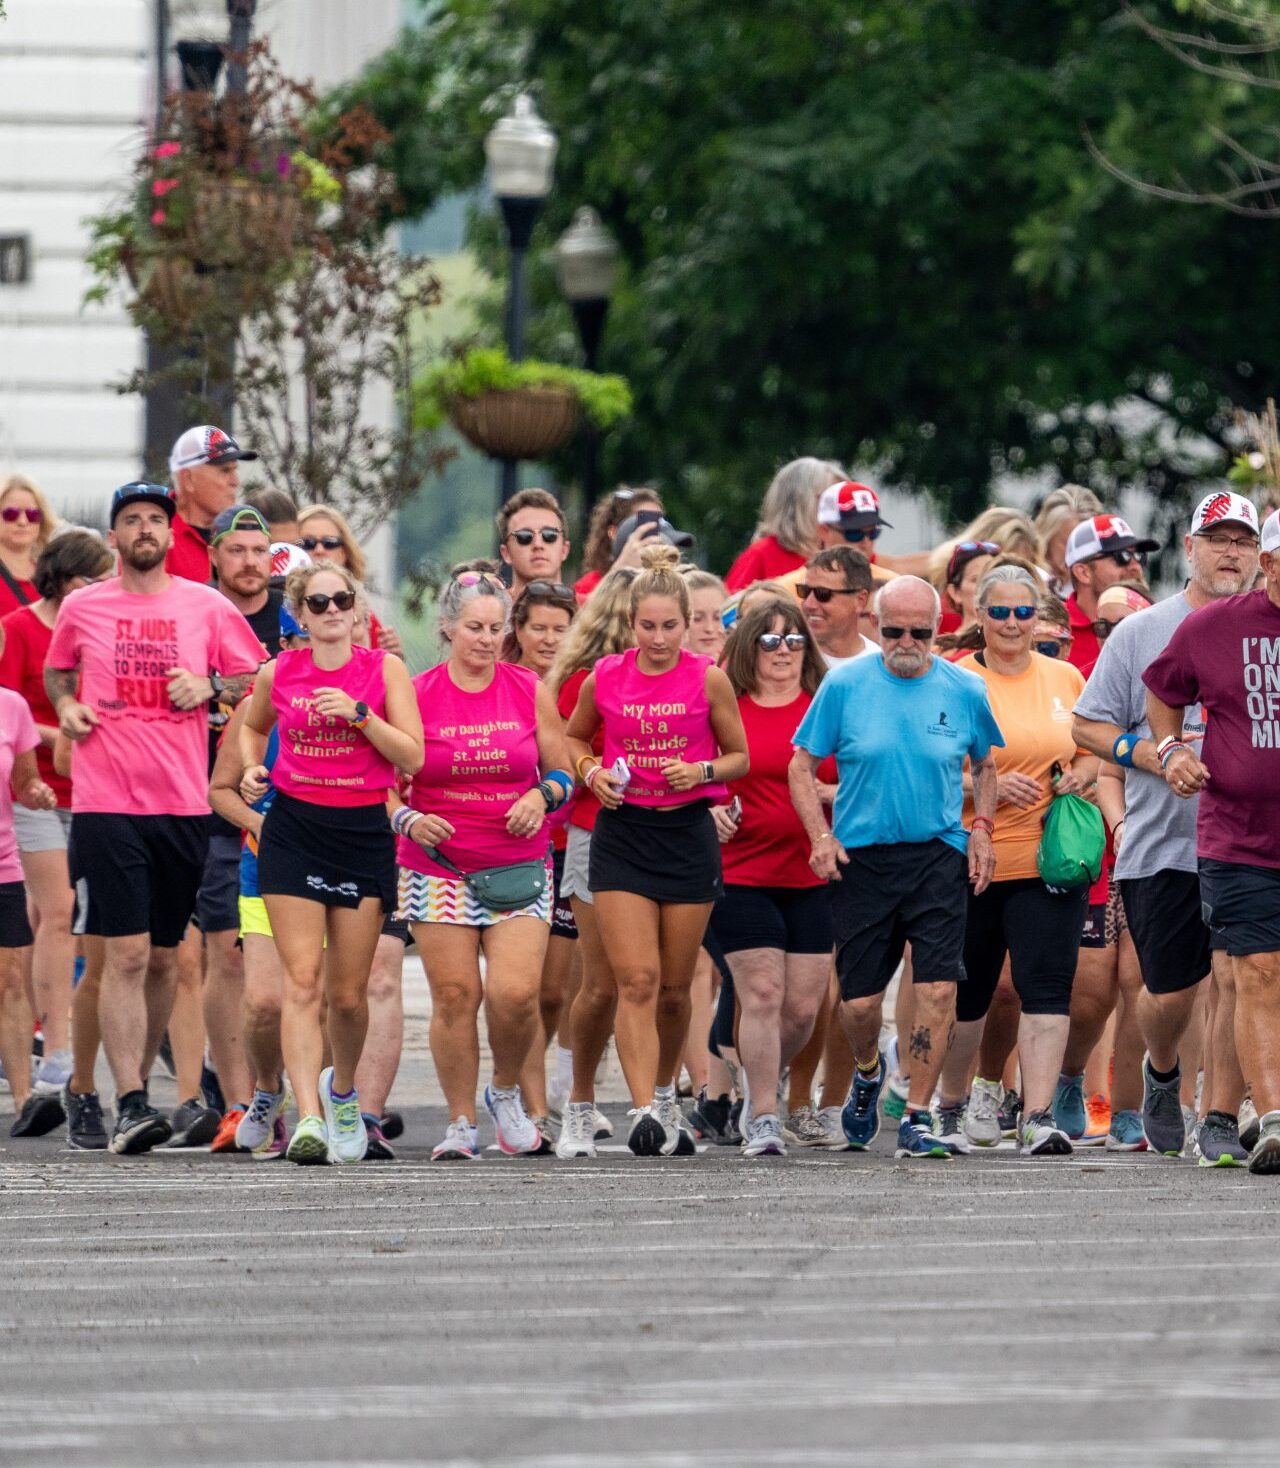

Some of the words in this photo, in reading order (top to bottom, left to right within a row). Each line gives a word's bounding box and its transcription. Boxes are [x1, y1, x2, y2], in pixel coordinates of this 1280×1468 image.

[115, 643, 179, 660] MEMPHIS
[115, 660, 129, 675] TO
[135, 661, 179, 678] PEOR
[622, 704, 645, 719] My
[649, 702, 686, 717] Mom
[1247, 691, 1280, 720] OF
[325, 715, 337, 727] a
[657, 720, 668, 733] a
[288, 728, 311, 742] St.
[315, 729, 357, 742] Jude
[460, 721, 521, 736] Daughters
[468, 737, 490, 748] are
[624, 737, 645, 751] St.
[648, 733, 688, 751] Jude
[453, 750, 471, 762] St.
[474, 748, 507, 761] Jude
[451, 764, 511, 776] Runners
[324, 777, 336, 786] to
[484, 793, 495, 801] to
